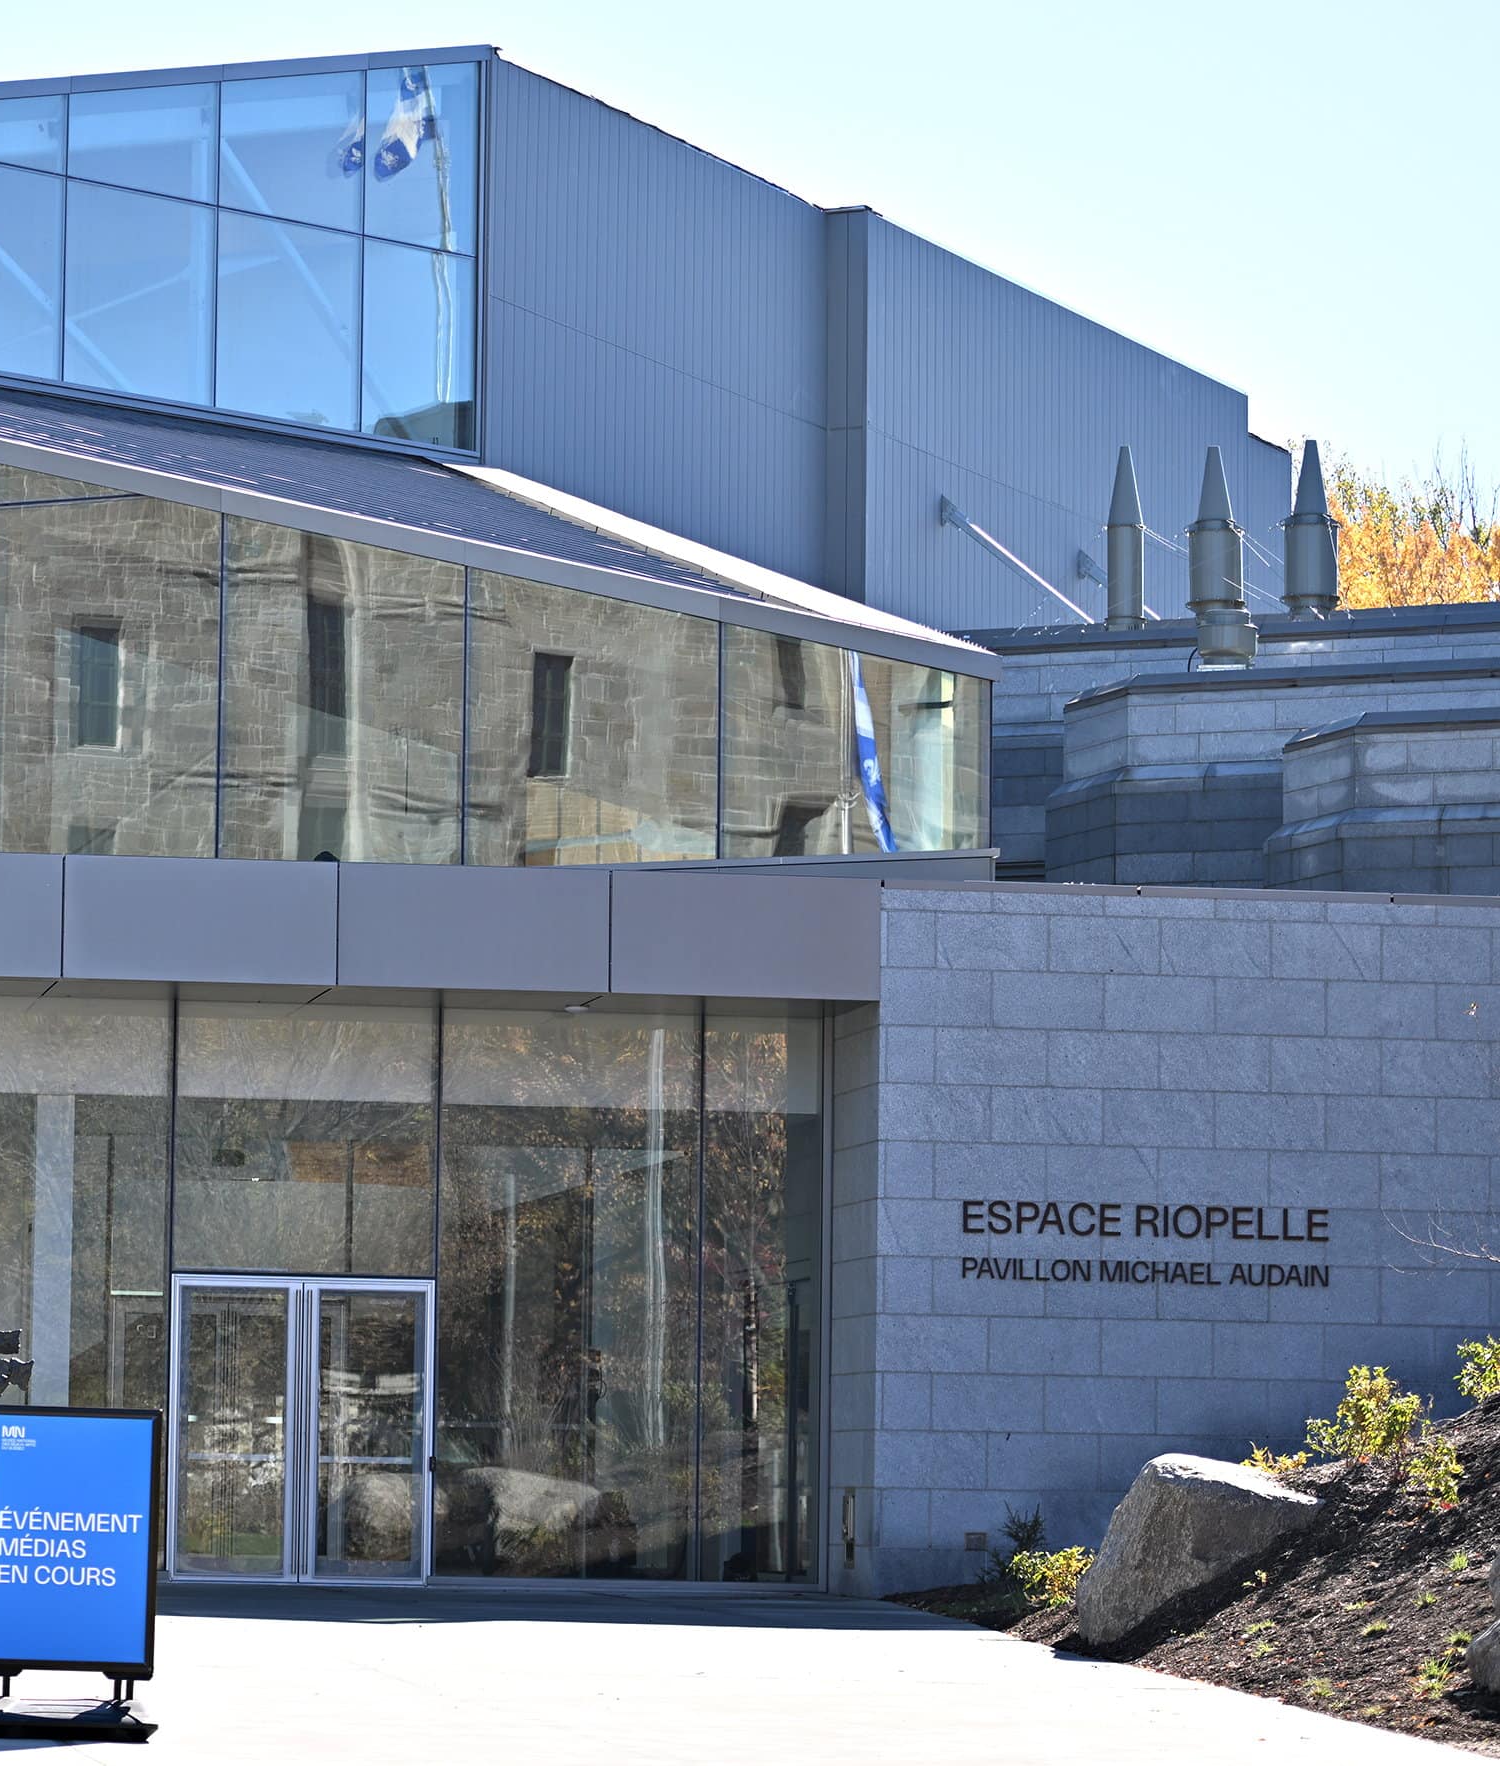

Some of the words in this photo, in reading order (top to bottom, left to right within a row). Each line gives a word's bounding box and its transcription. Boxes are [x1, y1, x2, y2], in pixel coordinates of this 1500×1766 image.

[961, 1199, 1122, 1237] ESPACE
[1135, 1204, 1330, 1242] RIOPELLE
[961, 1256, 1092, 1282] PAVILLON
[1099, 1260, 1222, 1285] MICHAEL
[1229, 1263, 1330, 1288] AUDAIN
[34, 1565, 117, 1587] COURS
